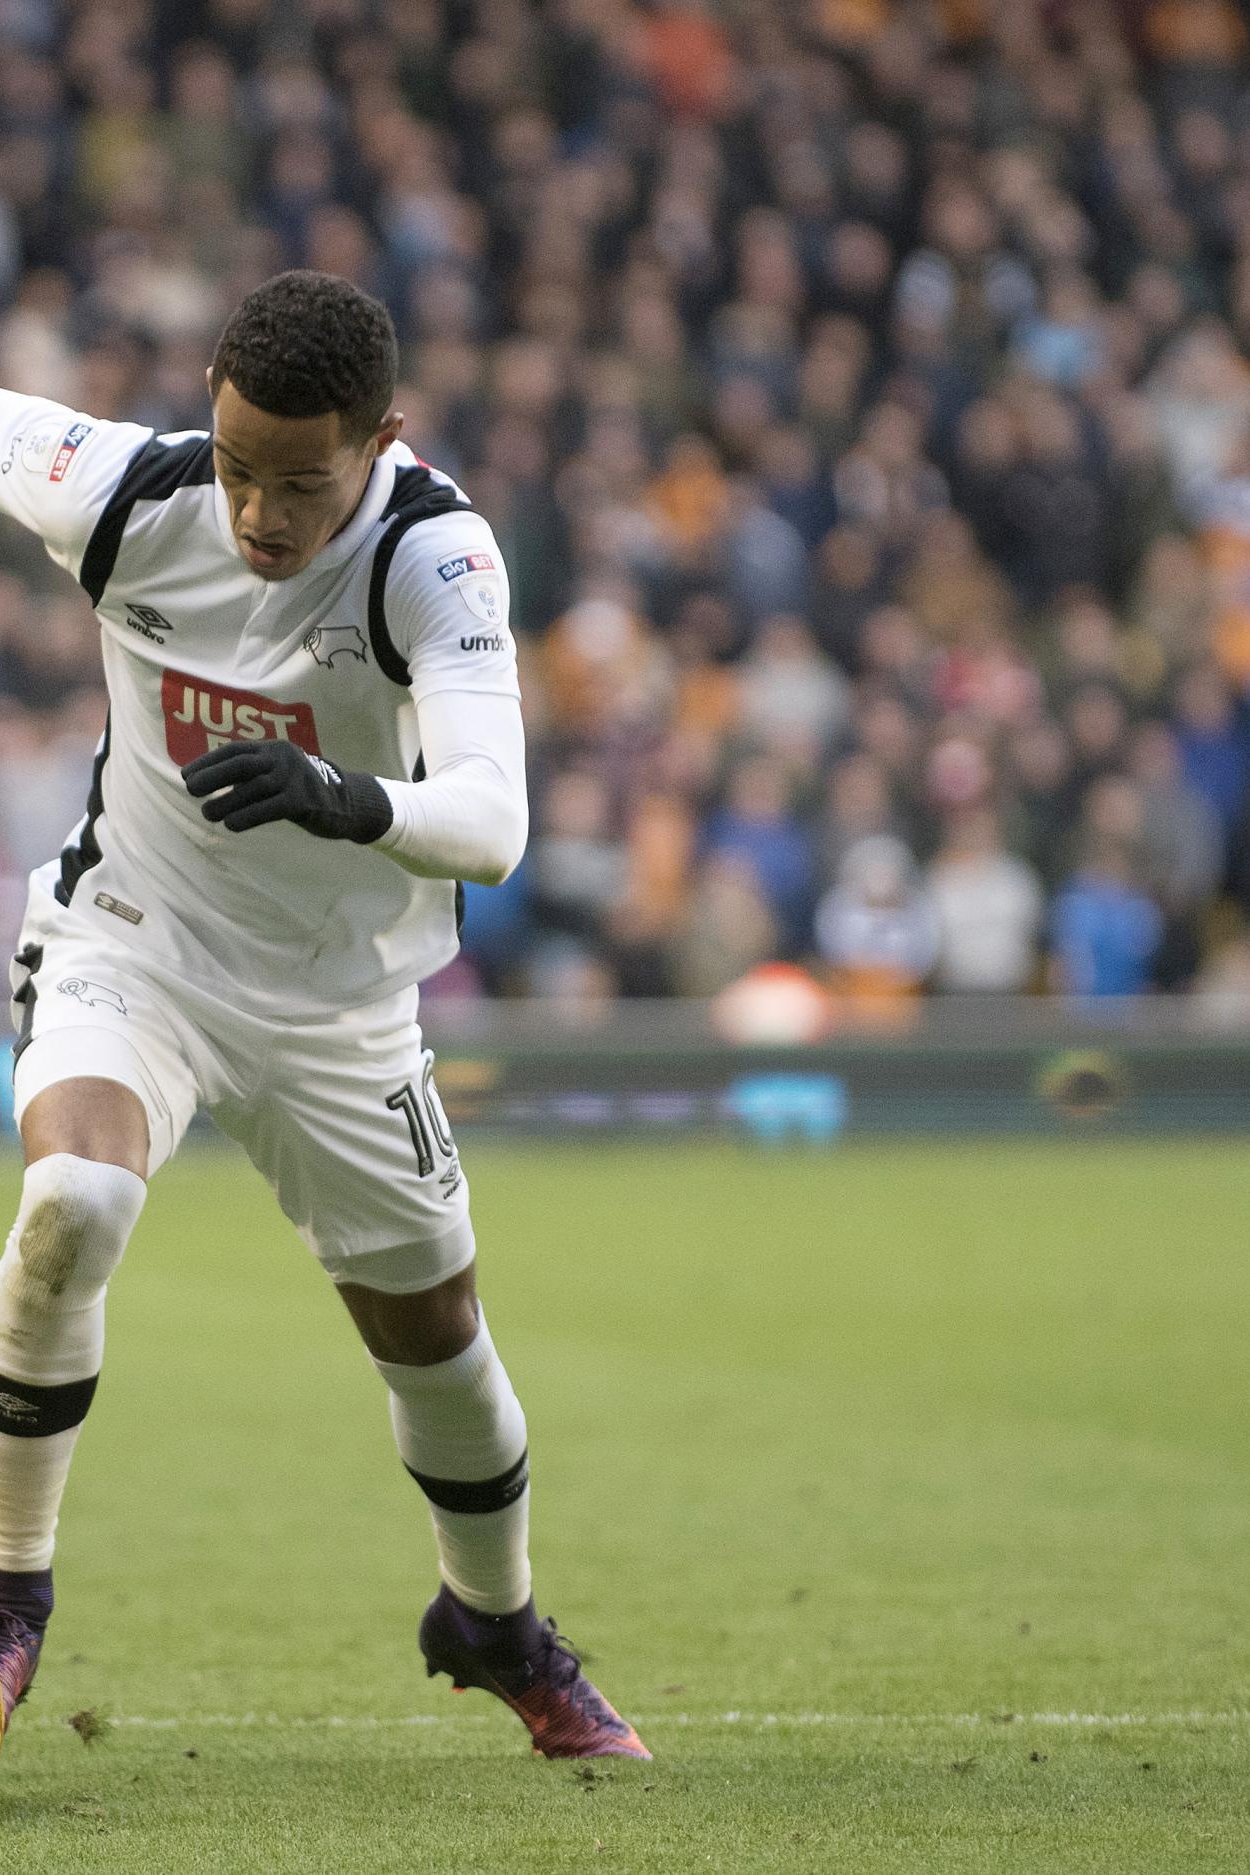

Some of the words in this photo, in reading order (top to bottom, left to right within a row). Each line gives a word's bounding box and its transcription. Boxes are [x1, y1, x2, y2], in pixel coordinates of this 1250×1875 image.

[53, 449, 72, 479] BET
[173, 686, 298, 742] JUST
[385, 1055, 453, 1178] 10
